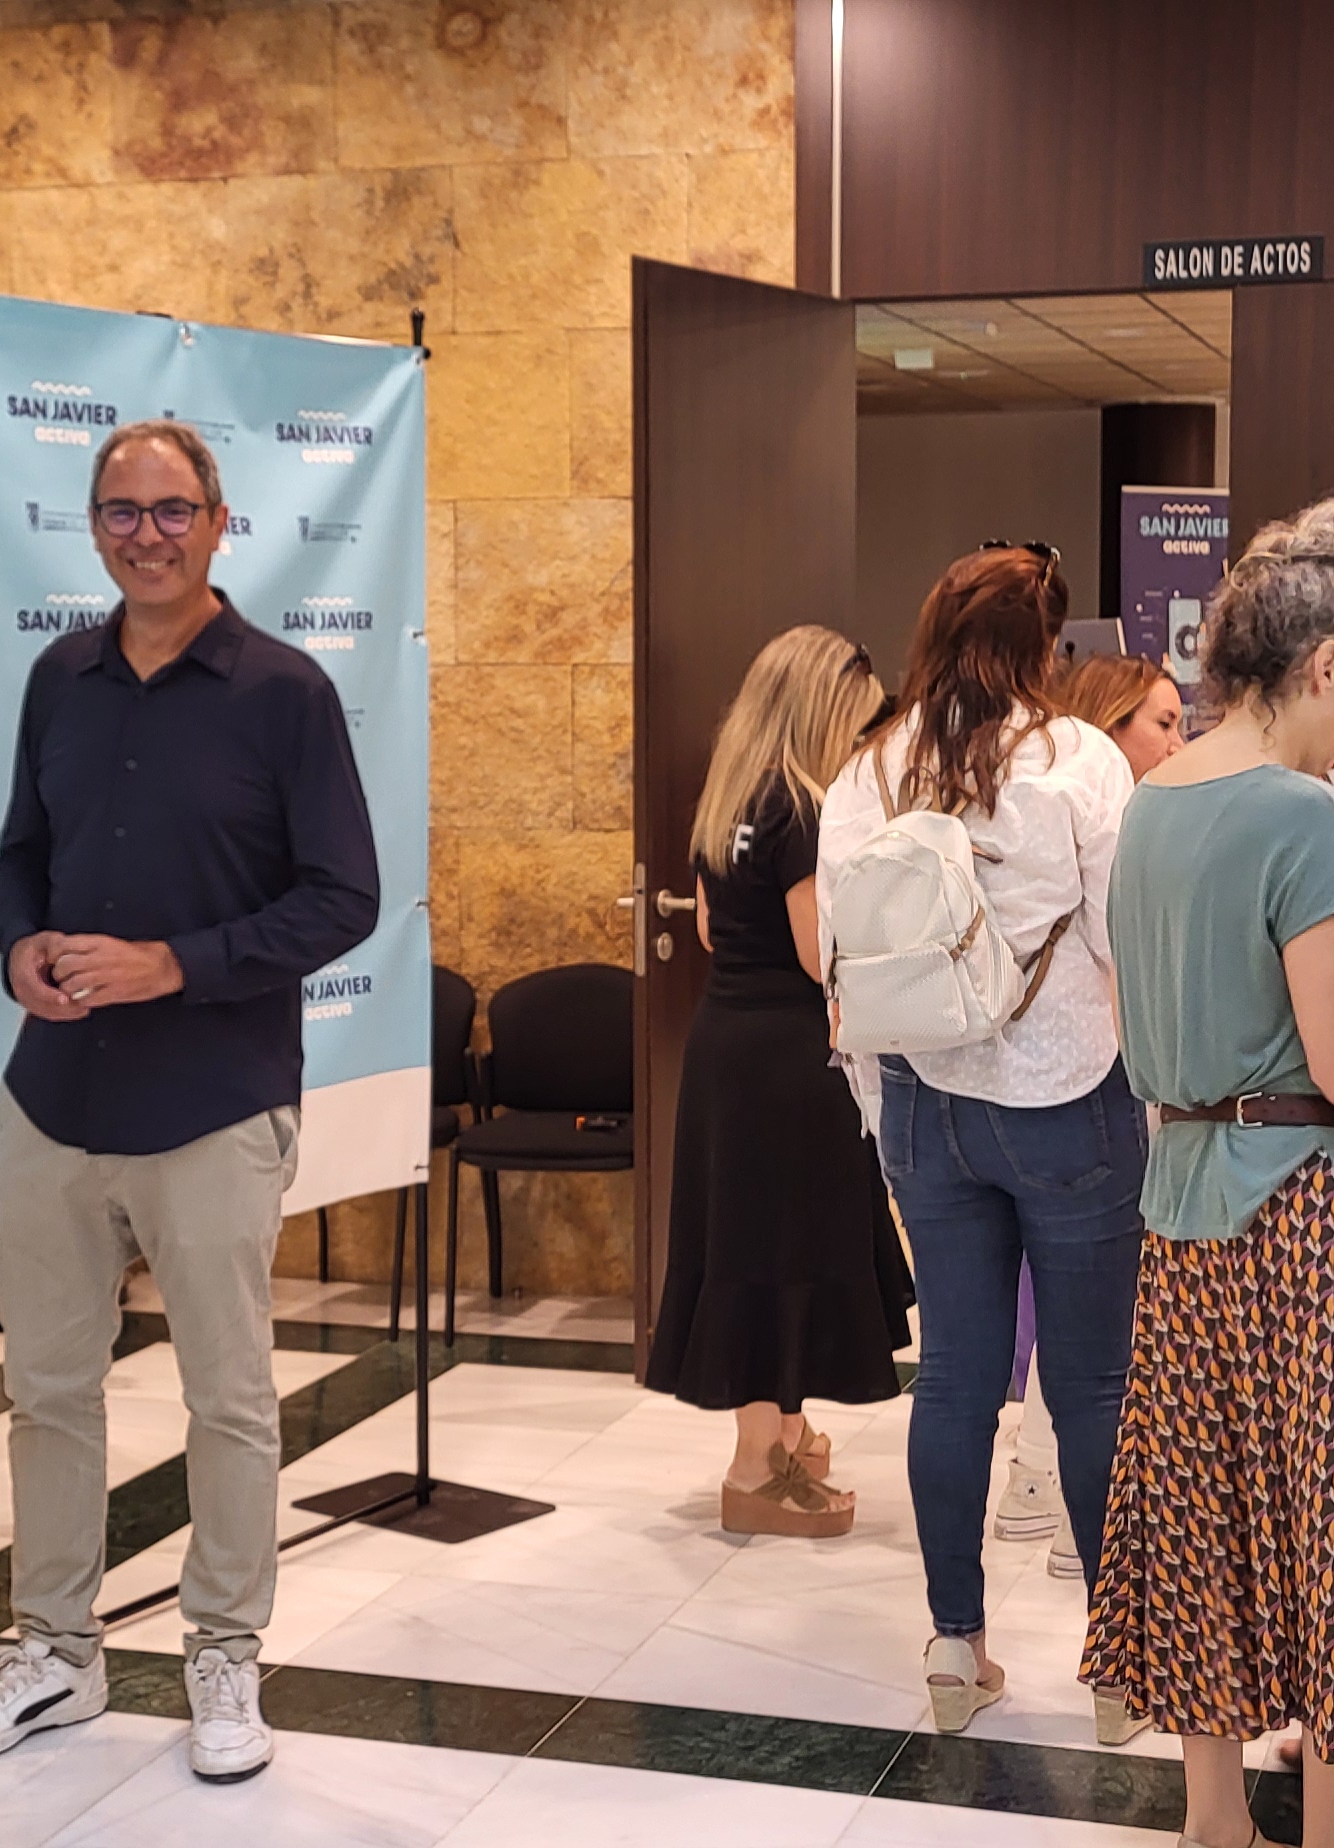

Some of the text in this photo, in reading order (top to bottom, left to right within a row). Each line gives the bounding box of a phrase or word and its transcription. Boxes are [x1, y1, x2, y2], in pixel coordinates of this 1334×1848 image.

[1154, 240, 1312, 280] SALON DE ACTOS
[7, 395, 117, 427] SAN JAVIER
[275, 422, 373, 446] SAN JAVIER
[1140, 515, 1175, 537] SAN
[17, 609, 62, 632] SAN
[282, 611, 373, 631] SAN JAVIER
[318, 975, 372, 1001] JAVIER
